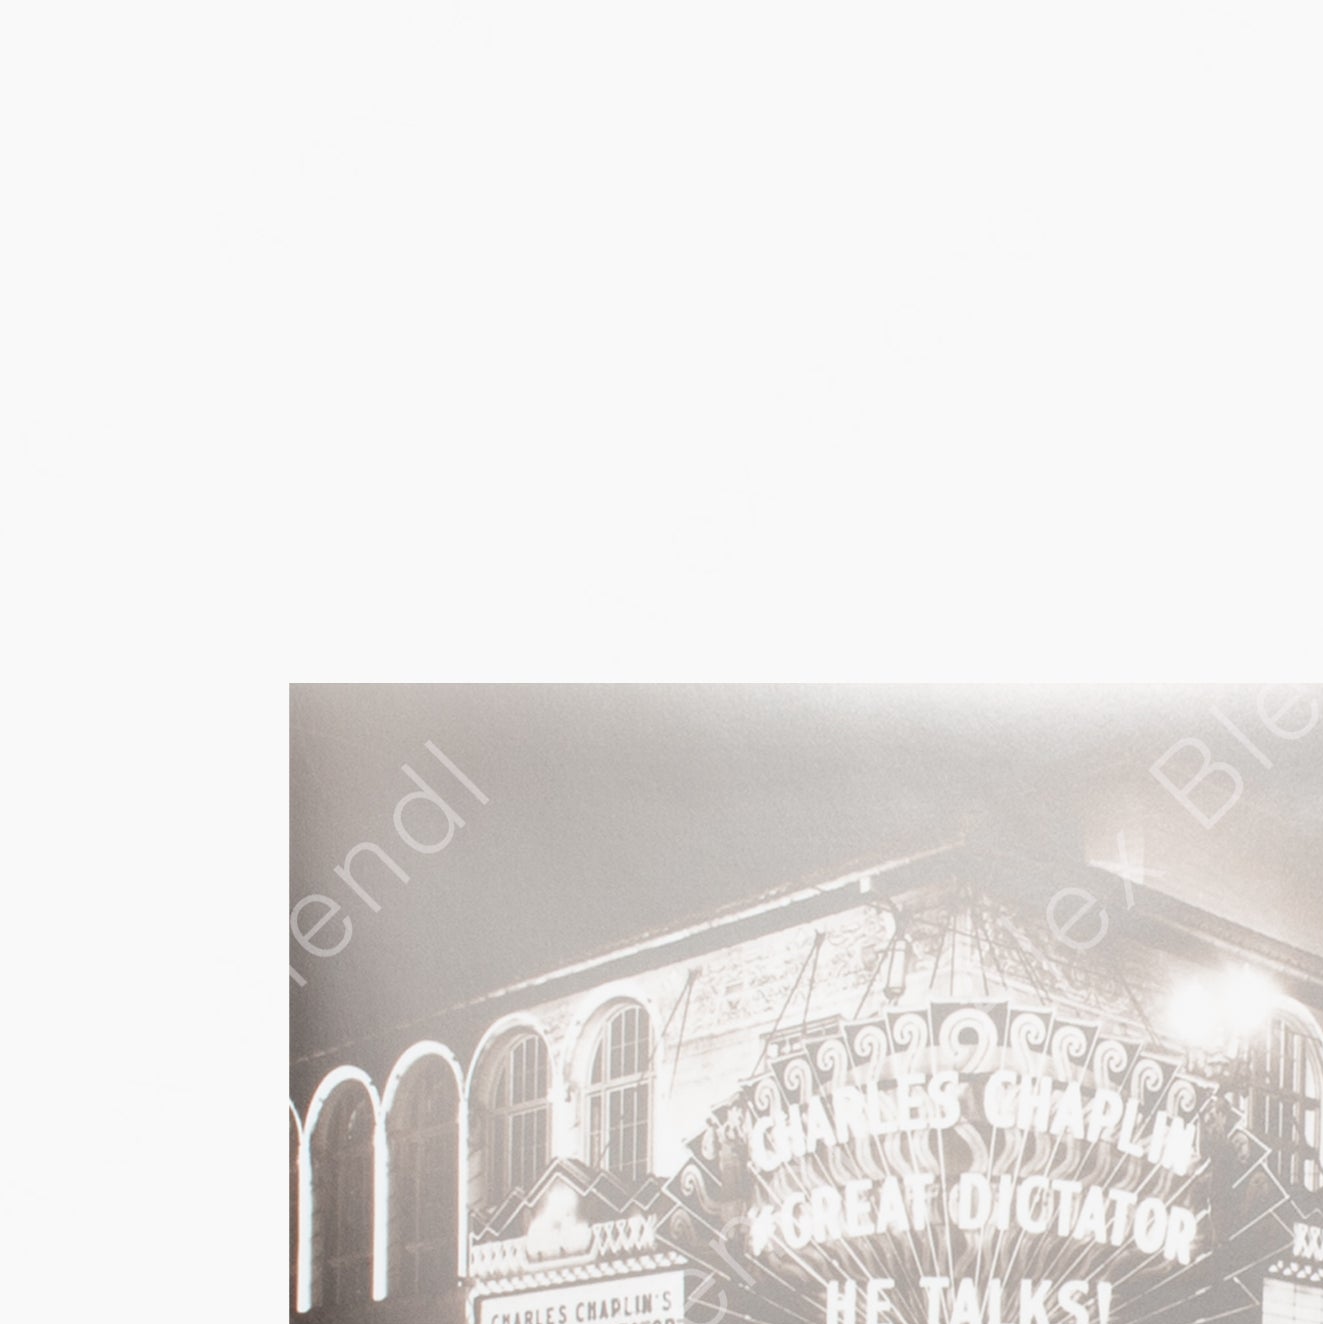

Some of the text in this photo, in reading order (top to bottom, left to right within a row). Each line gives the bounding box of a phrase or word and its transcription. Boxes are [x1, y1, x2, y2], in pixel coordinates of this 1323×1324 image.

[749, 1069, 1199, 1177] CHARLES CHAPLIN
[780, 1173, 936, 1251] GREAT
[957, 1171, 1198, 1265] DICTATOR
[575, 1291, 672, 1323] CHAPLIN'S
